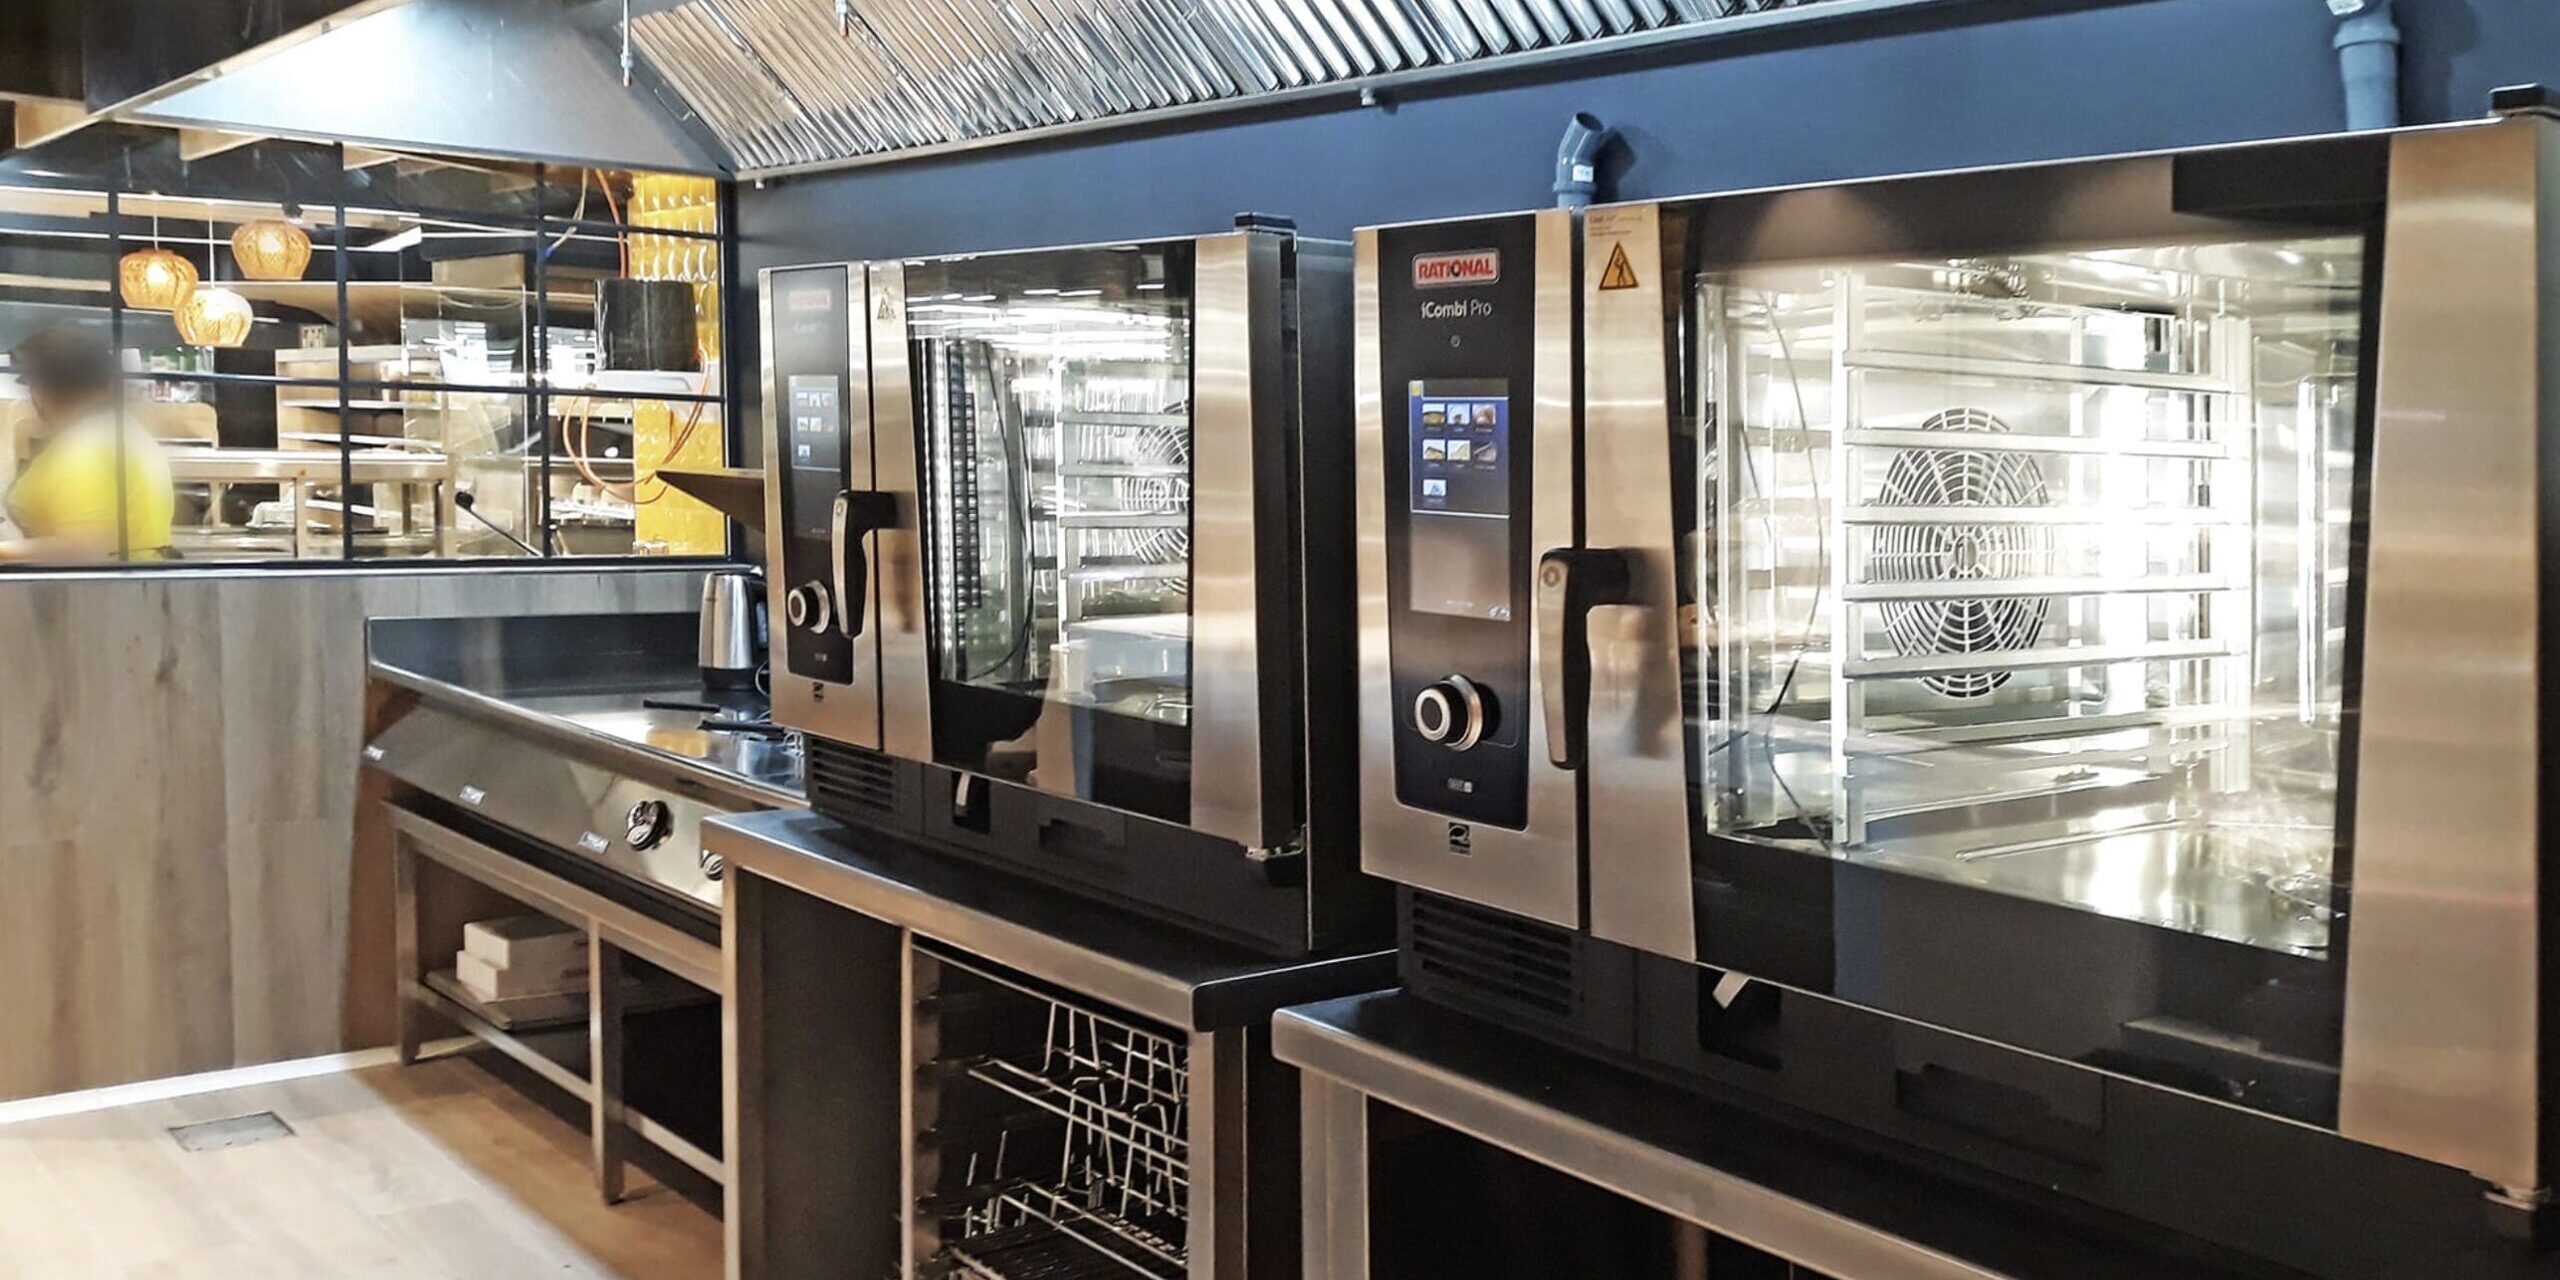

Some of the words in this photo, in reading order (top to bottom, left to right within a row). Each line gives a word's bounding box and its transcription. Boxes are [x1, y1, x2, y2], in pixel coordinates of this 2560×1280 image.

[1418, 258, 1493, 279] RATIONAL
[1421, 300, 1467, 318] iCombi
[1470, 298, 1492, 316] Pro
